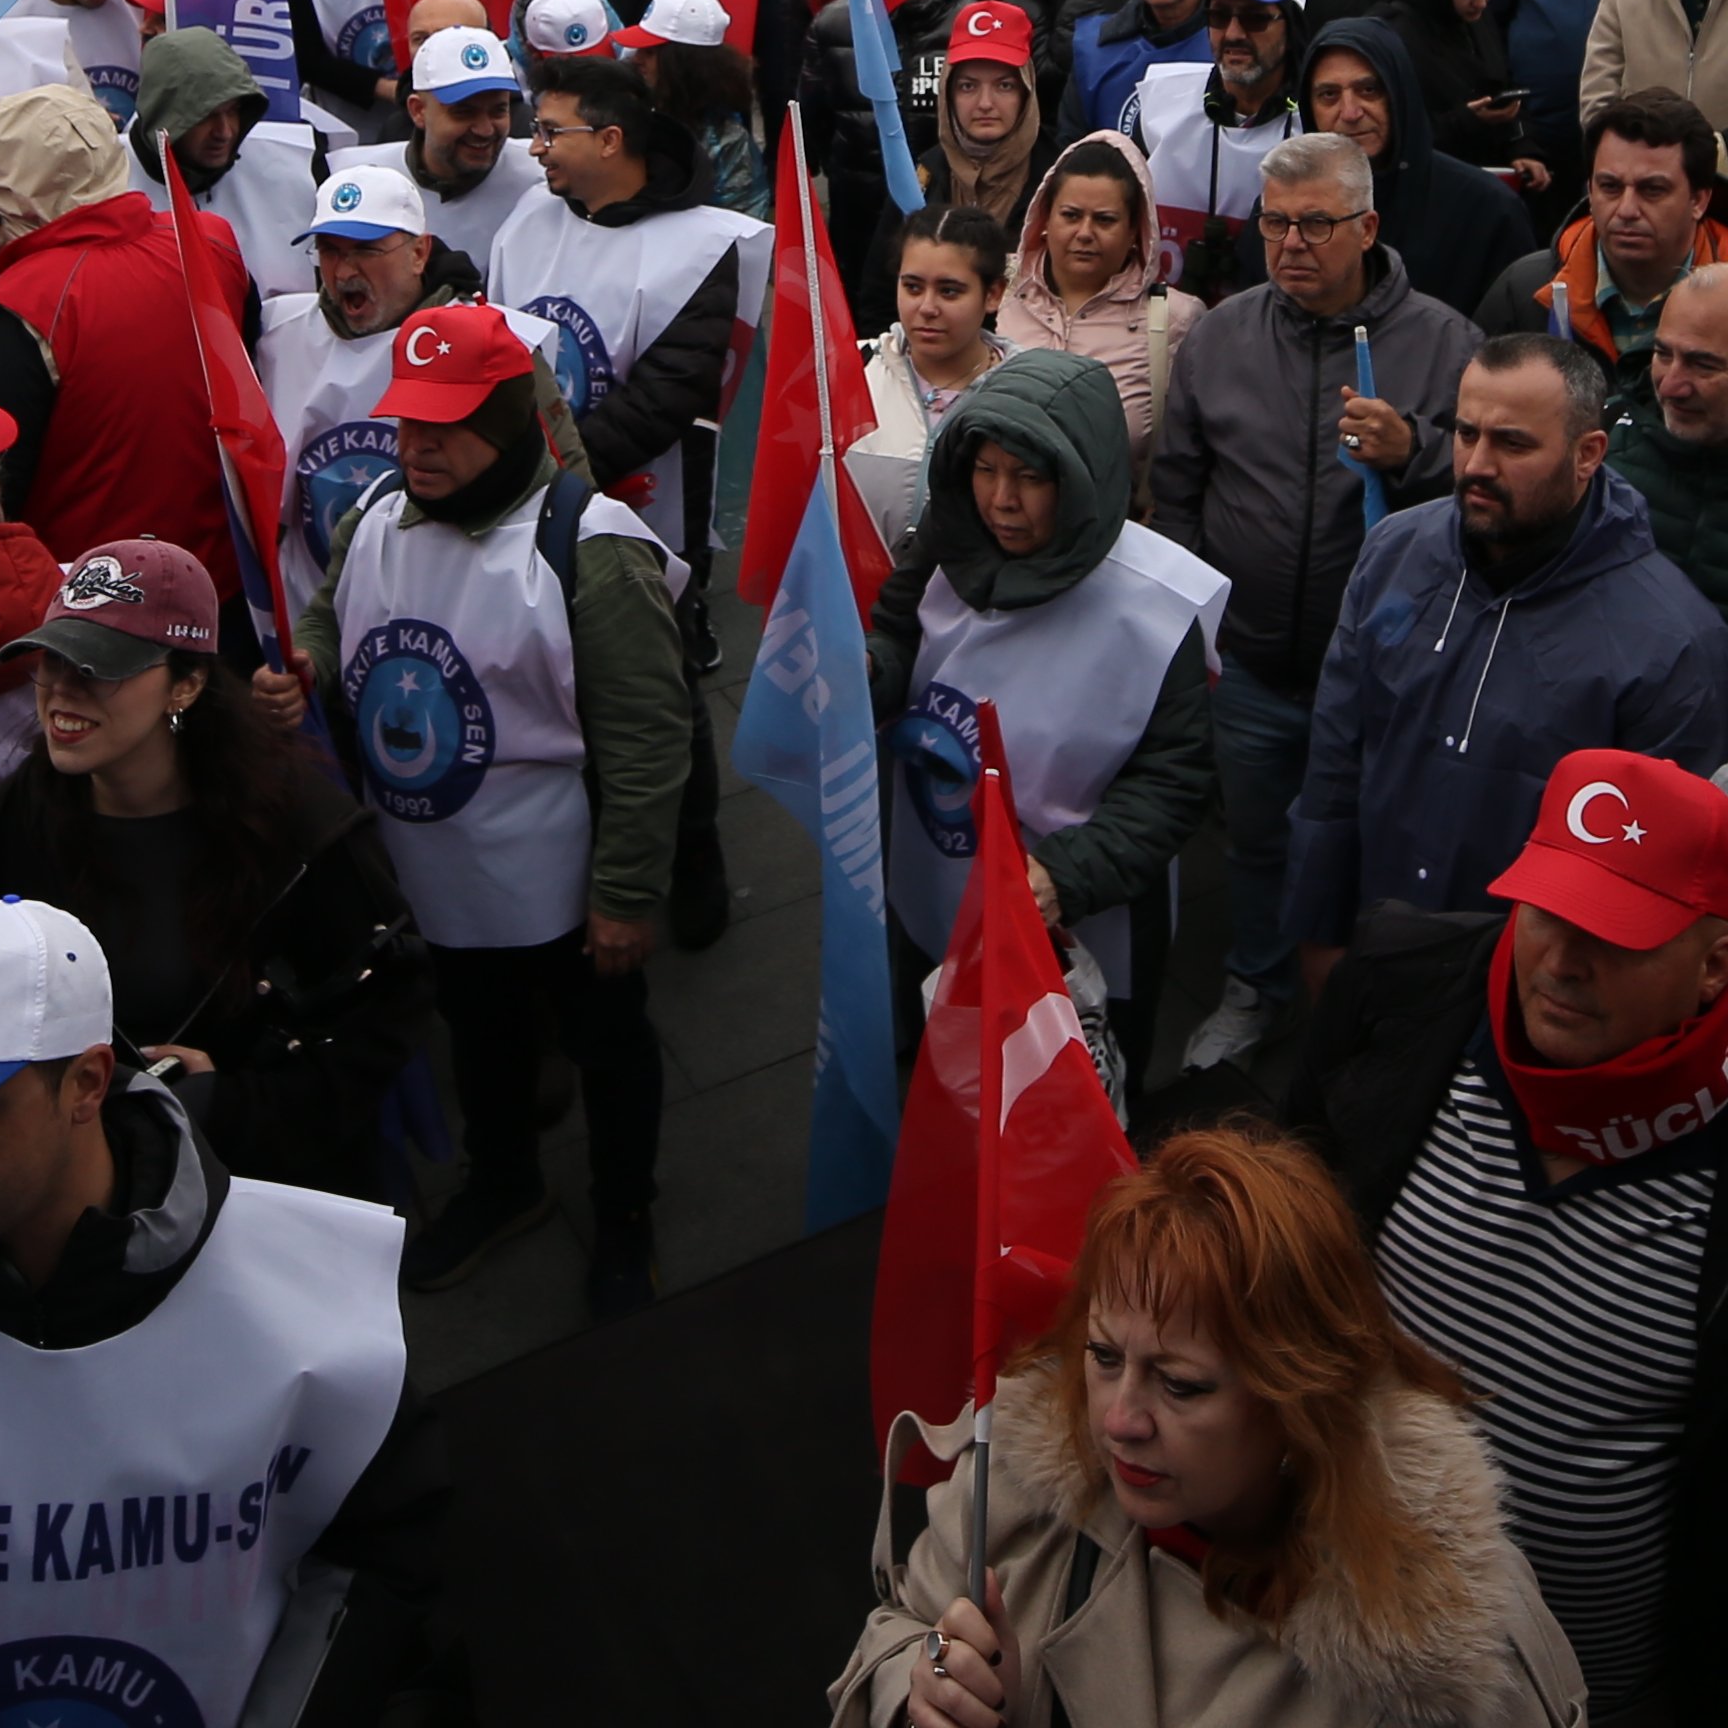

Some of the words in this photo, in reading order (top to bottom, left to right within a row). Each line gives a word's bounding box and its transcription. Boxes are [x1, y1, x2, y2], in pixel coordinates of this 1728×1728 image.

[397, 628, 460, 680] KAMU
[462, 703, 489, 766] SEN
[384, 790, 435, 818] 1992
[12, 1652, 158, 1701] KAMU
